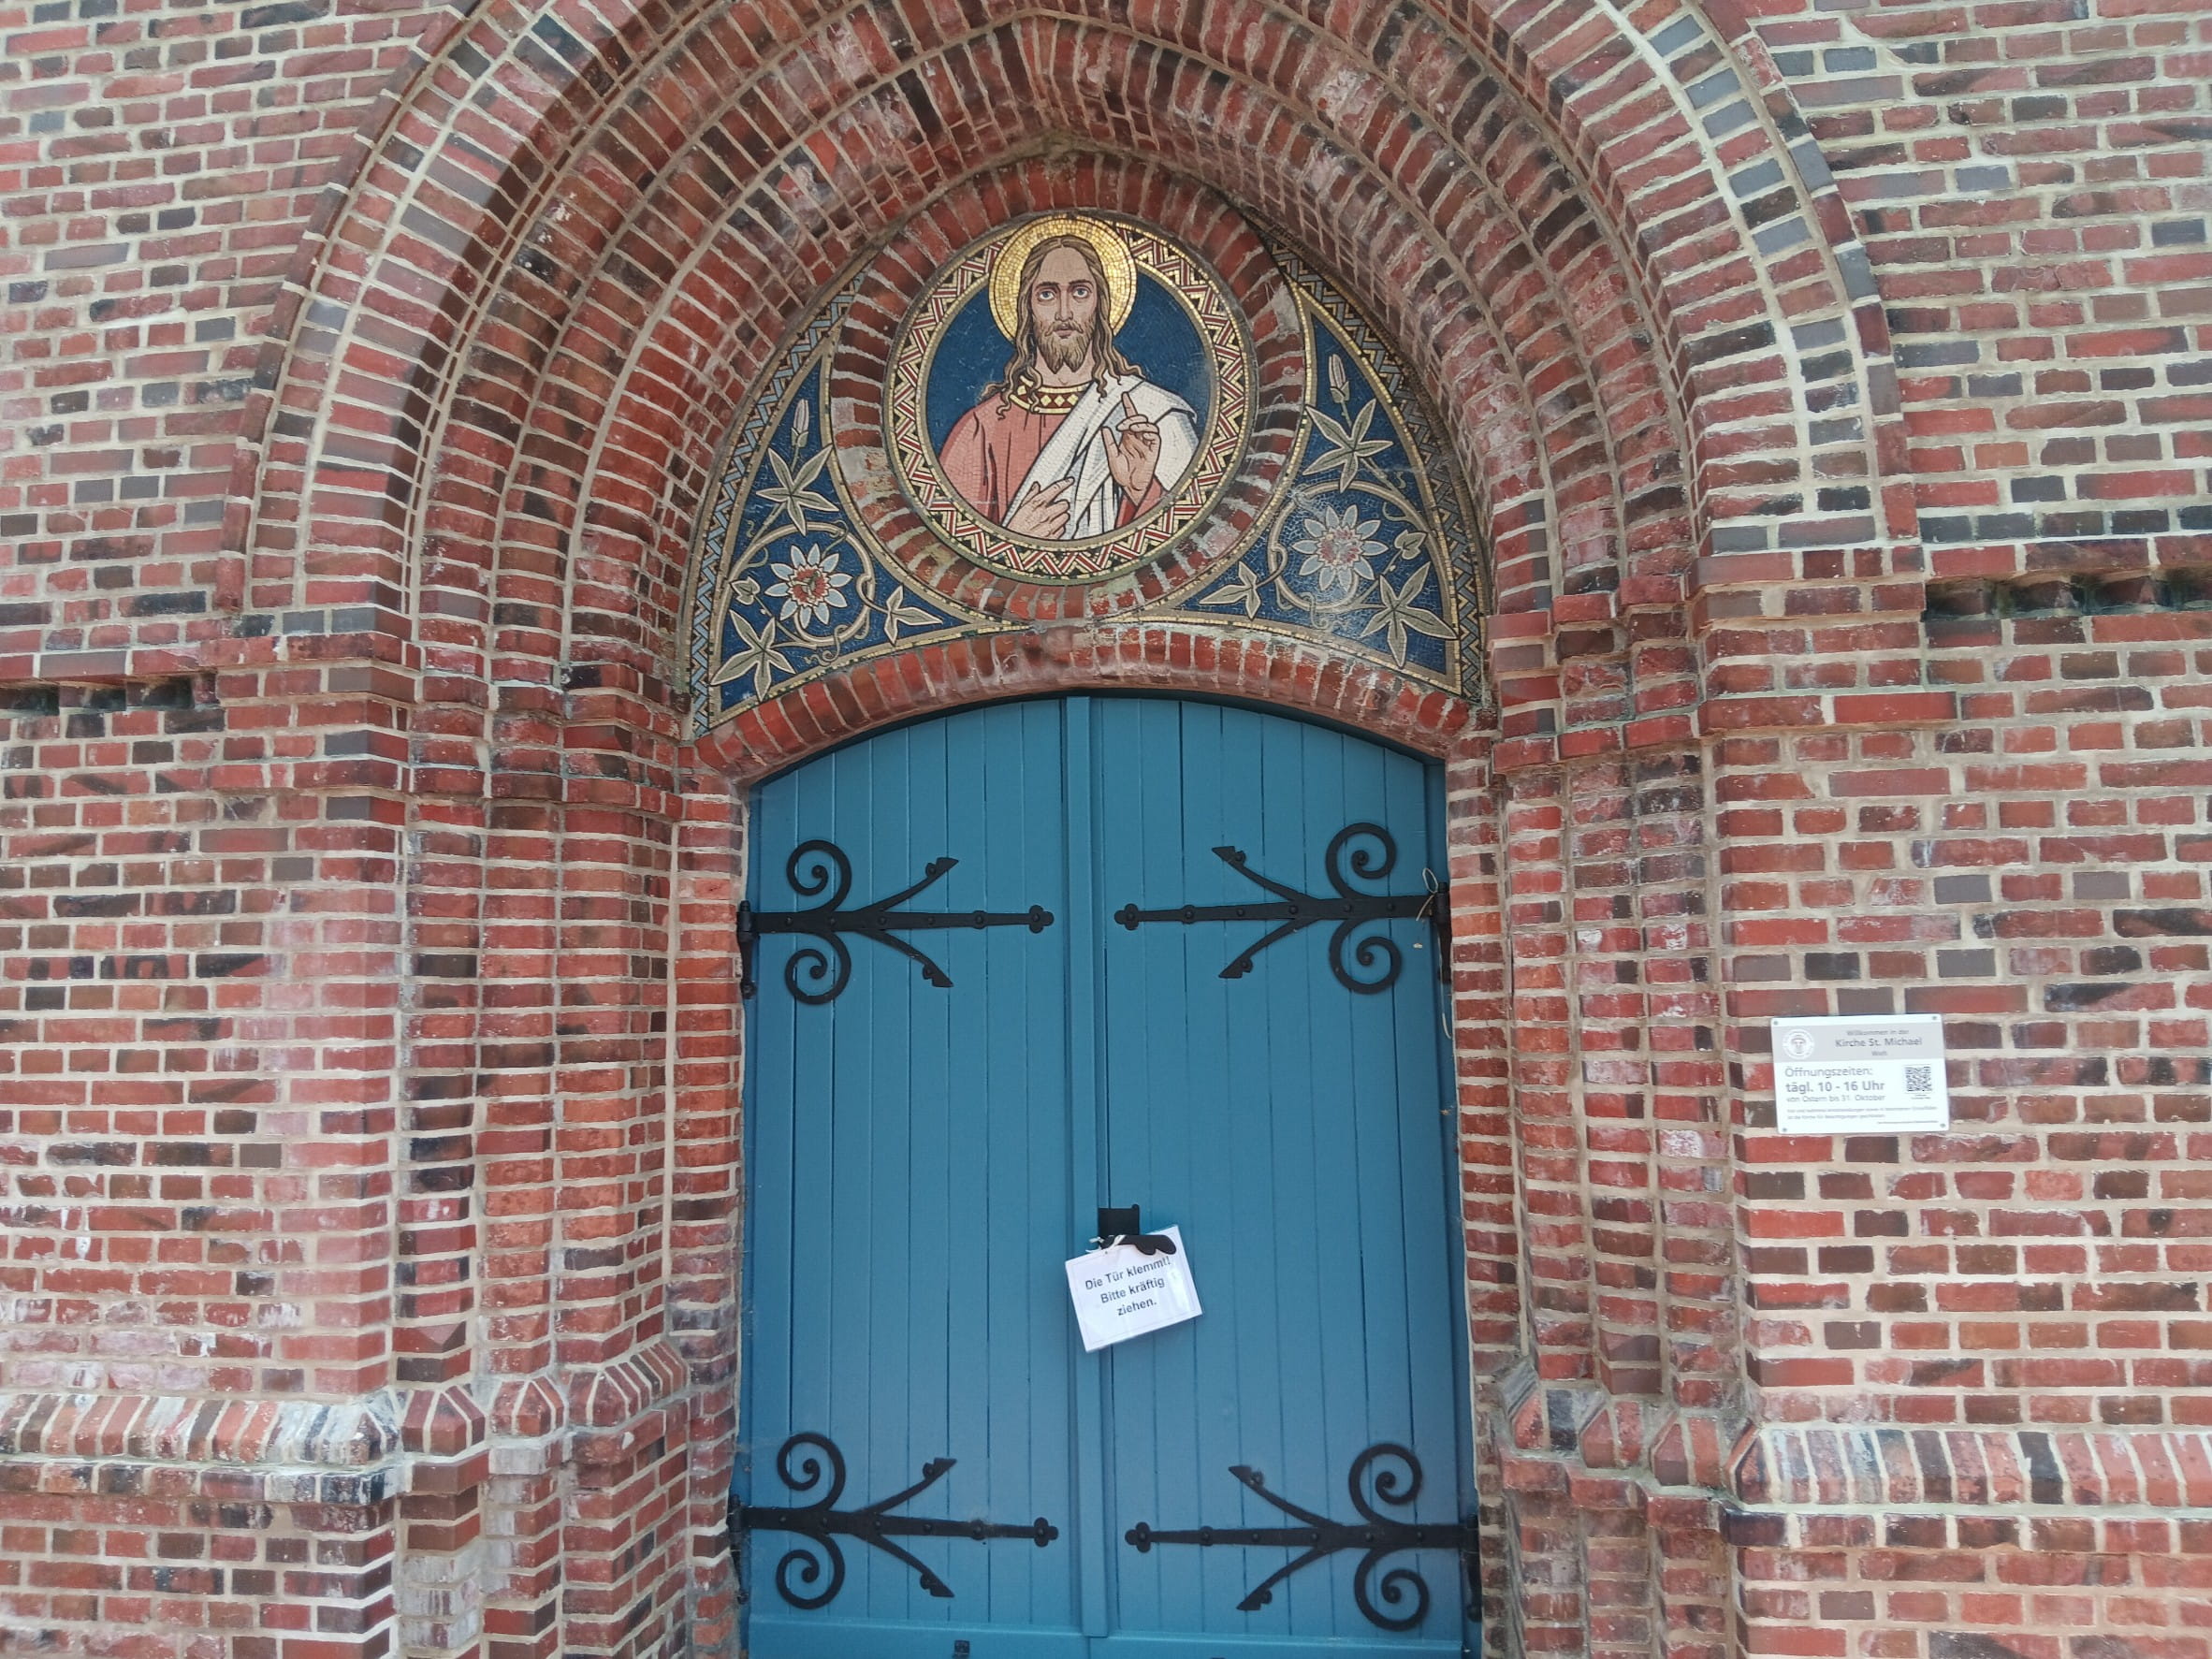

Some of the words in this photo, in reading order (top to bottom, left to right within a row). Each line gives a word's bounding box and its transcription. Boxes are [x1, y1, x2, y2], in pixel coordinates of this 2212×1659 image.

[1835, 1039, 1866, 1048] Kirche
[1869, 1038, 1882, 1046] St.
[1885, 1037, 1923, 1046] Michael
[1785, 1066, 1872, 1079] Öffnungszeiten:
[1785, 1083, 1813, 1094] tägl.
[1818, 1083, 1833, 1092] 10
[1844, 1082, 1858, 1091] 16
[1862, 1081, 1885, 1090] Uhr
[1085, 1277, 1103, 1290] Die
[1106, 1271, 1125, 1284] Tür
[1127, 1256, 1171, 1278] klemmt!
[1100, 1289, 1126, 1303] Bitte
[1128, 1278, 1166, 1294] kräftig
[1117, 1298, 1157, 1316] ziehen.
